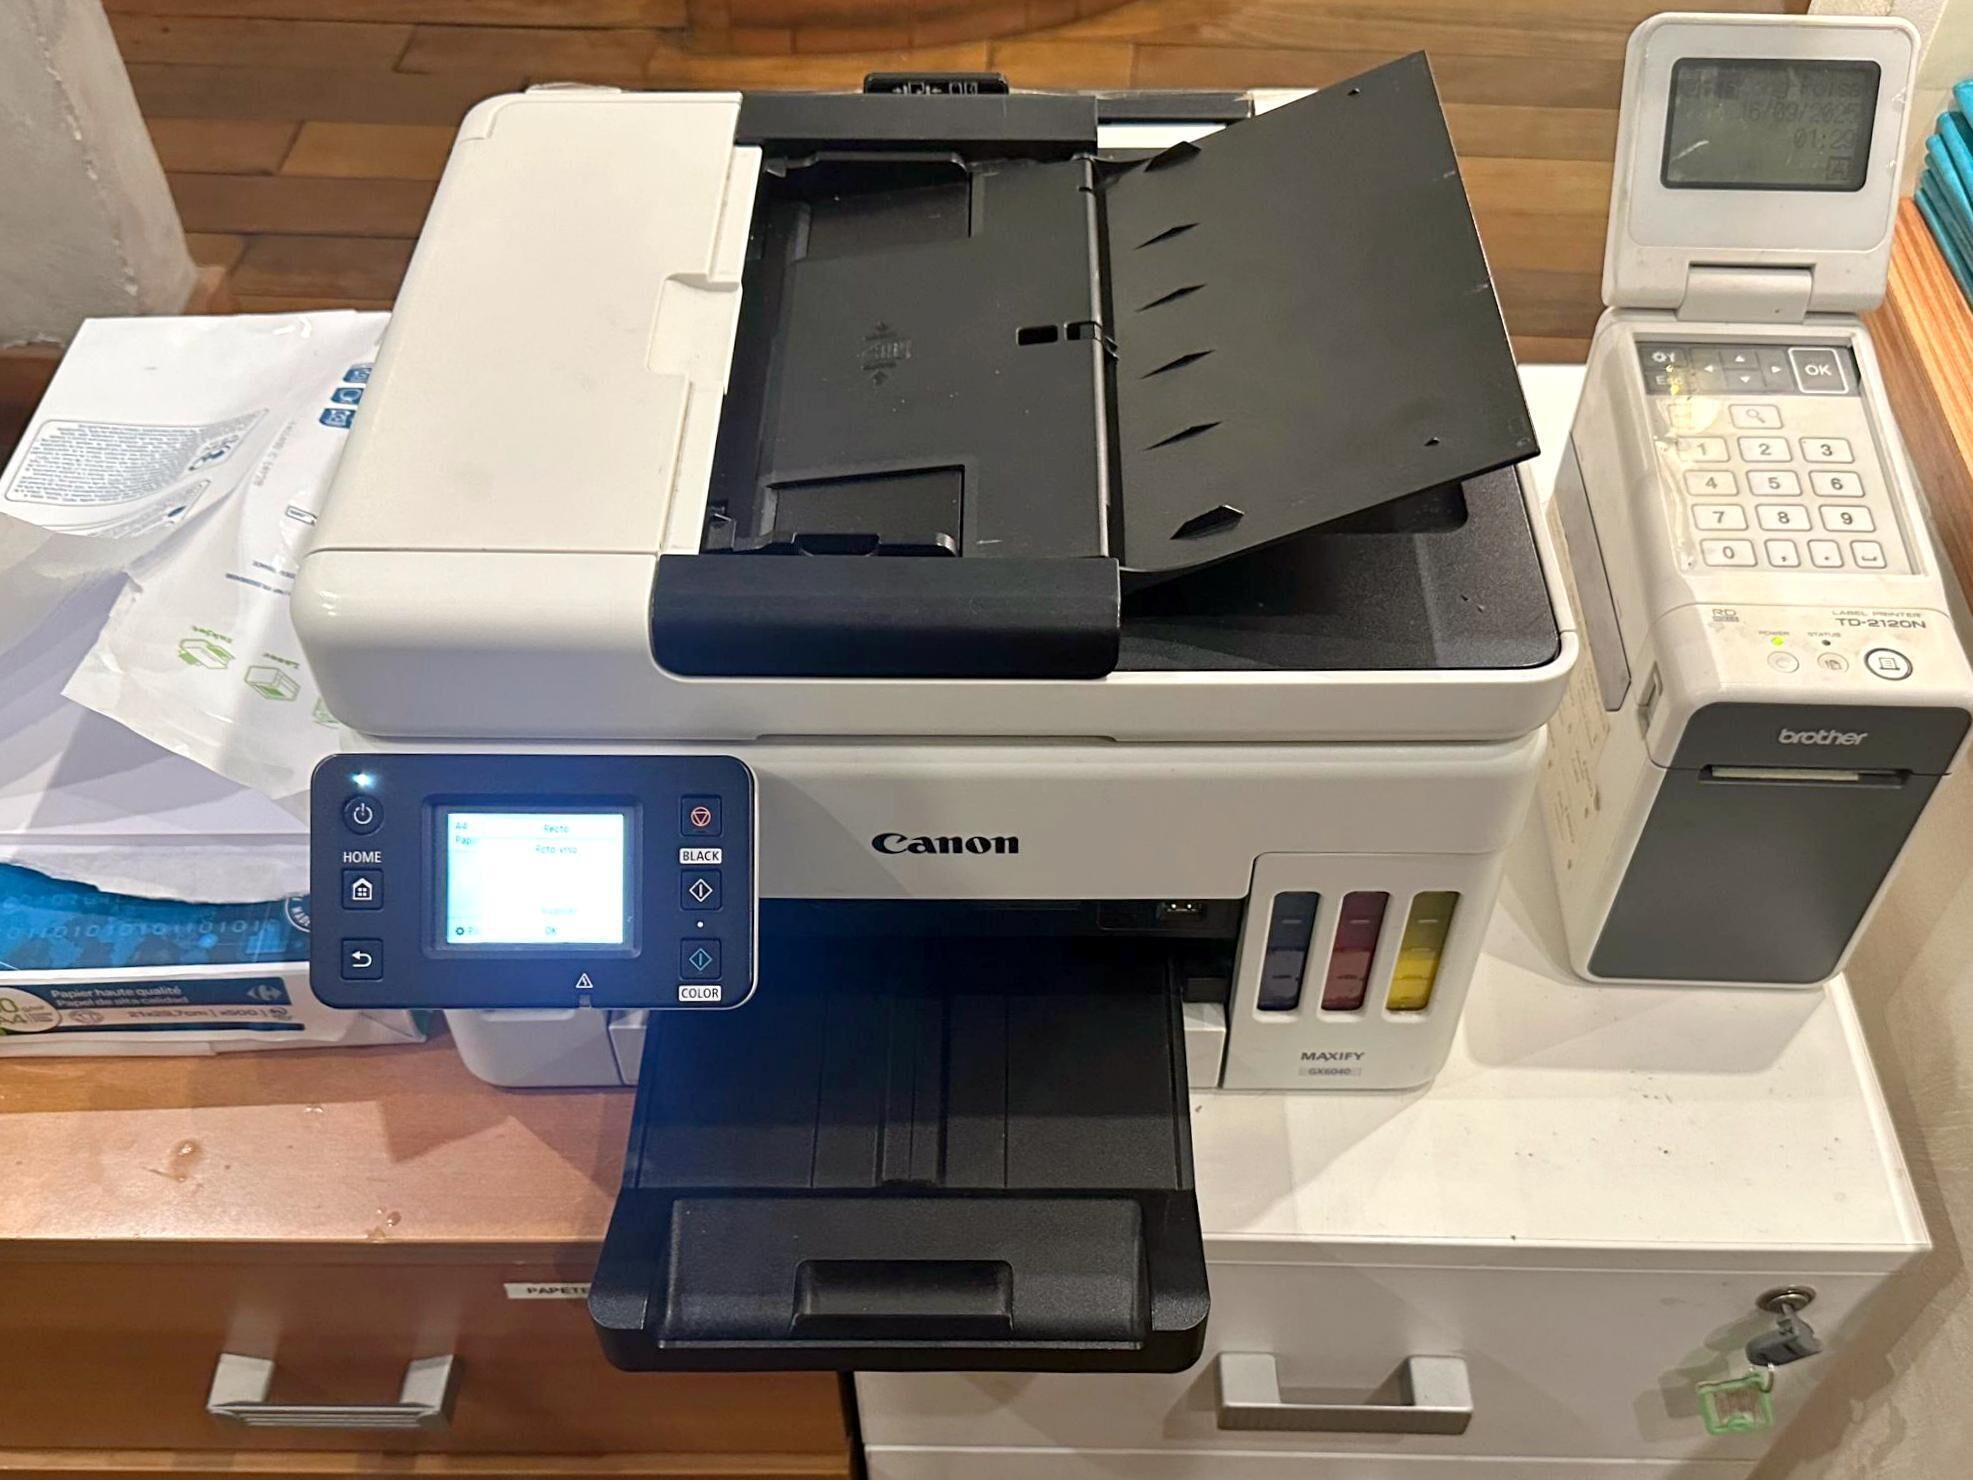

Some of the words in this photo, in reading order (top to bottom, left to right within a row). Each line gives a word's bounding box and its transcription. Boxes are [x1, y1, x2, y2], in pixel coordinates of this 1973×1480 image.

[1804, 364, 1832, 376] OK
[1696, 442, 1706, 456] 1
[1759, 442, 1771, 456] 2
[1820, 443, 1832, 457] 3
[1704, 476, 1717, 489] 4
[1768, 476, 1780, 489] 5
[1831, 477, 1843, 490] 6
[1712, 511, 1725, 524] 7
[1777, 511, 1790, 524] 8
[1840, 512, 1853, 525] 9
[1722, 546, 1735, 560] 0
[1835, 618, 1926, 628] TD-2120N
[1778, 728, 1867, 745] brother
[872, 833, 1019, 855] Canon
[343, 851, 381, 863] HOME
[682, 850, 719, 862] BLACK
[51, 989, 92, 999] Papier
[95, 988, 134, 997] haute
[136, 985, 181, 998] qualité
[681, 988, 719, 999] COLOR
[1301, 1052, 1365, 1061] MAXIFY
